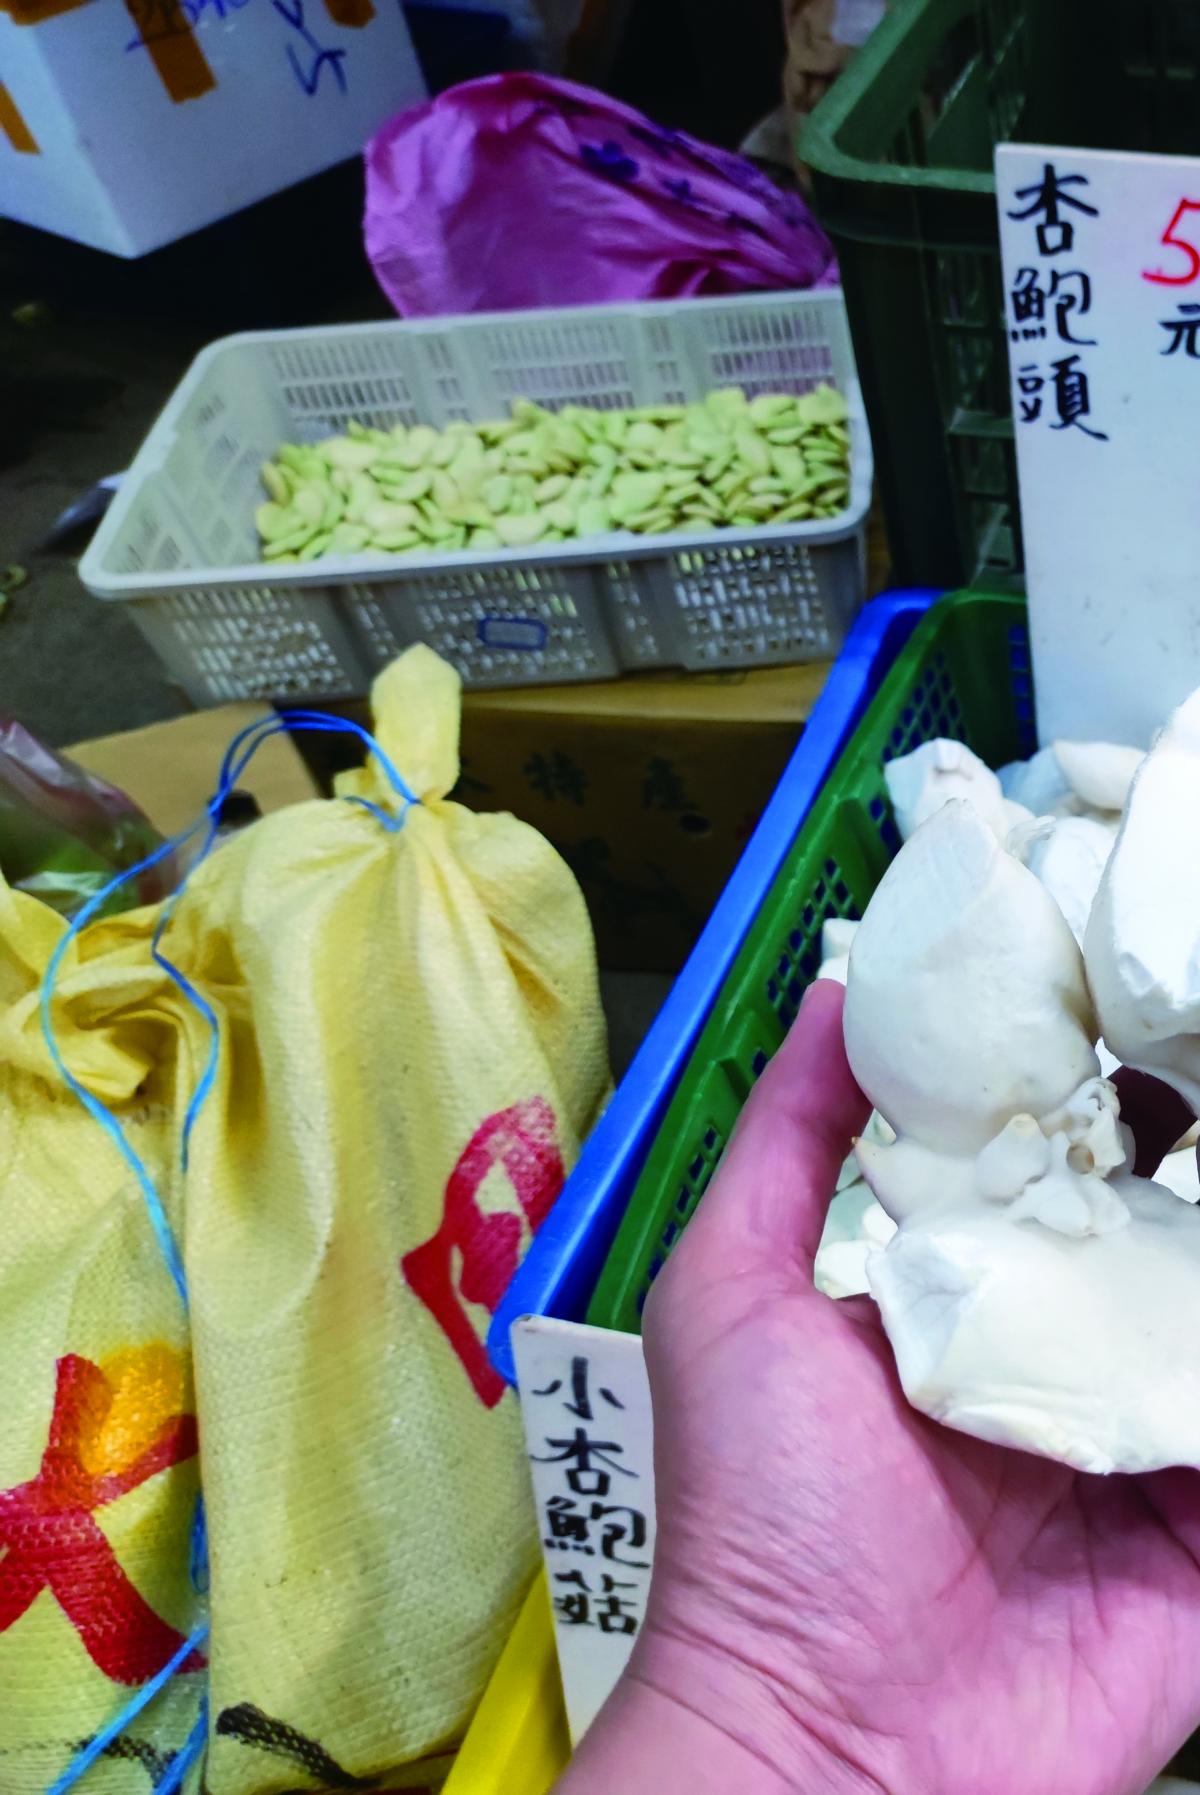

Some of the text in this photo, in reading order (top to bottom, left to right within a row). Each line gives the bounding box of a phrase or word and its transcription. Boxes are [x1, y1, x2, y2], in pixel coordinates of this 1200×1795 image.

[1006, 162, 1110, 442] 杏鮑頭
[529, 1355, 652, 1637] 小杏鮑菇
